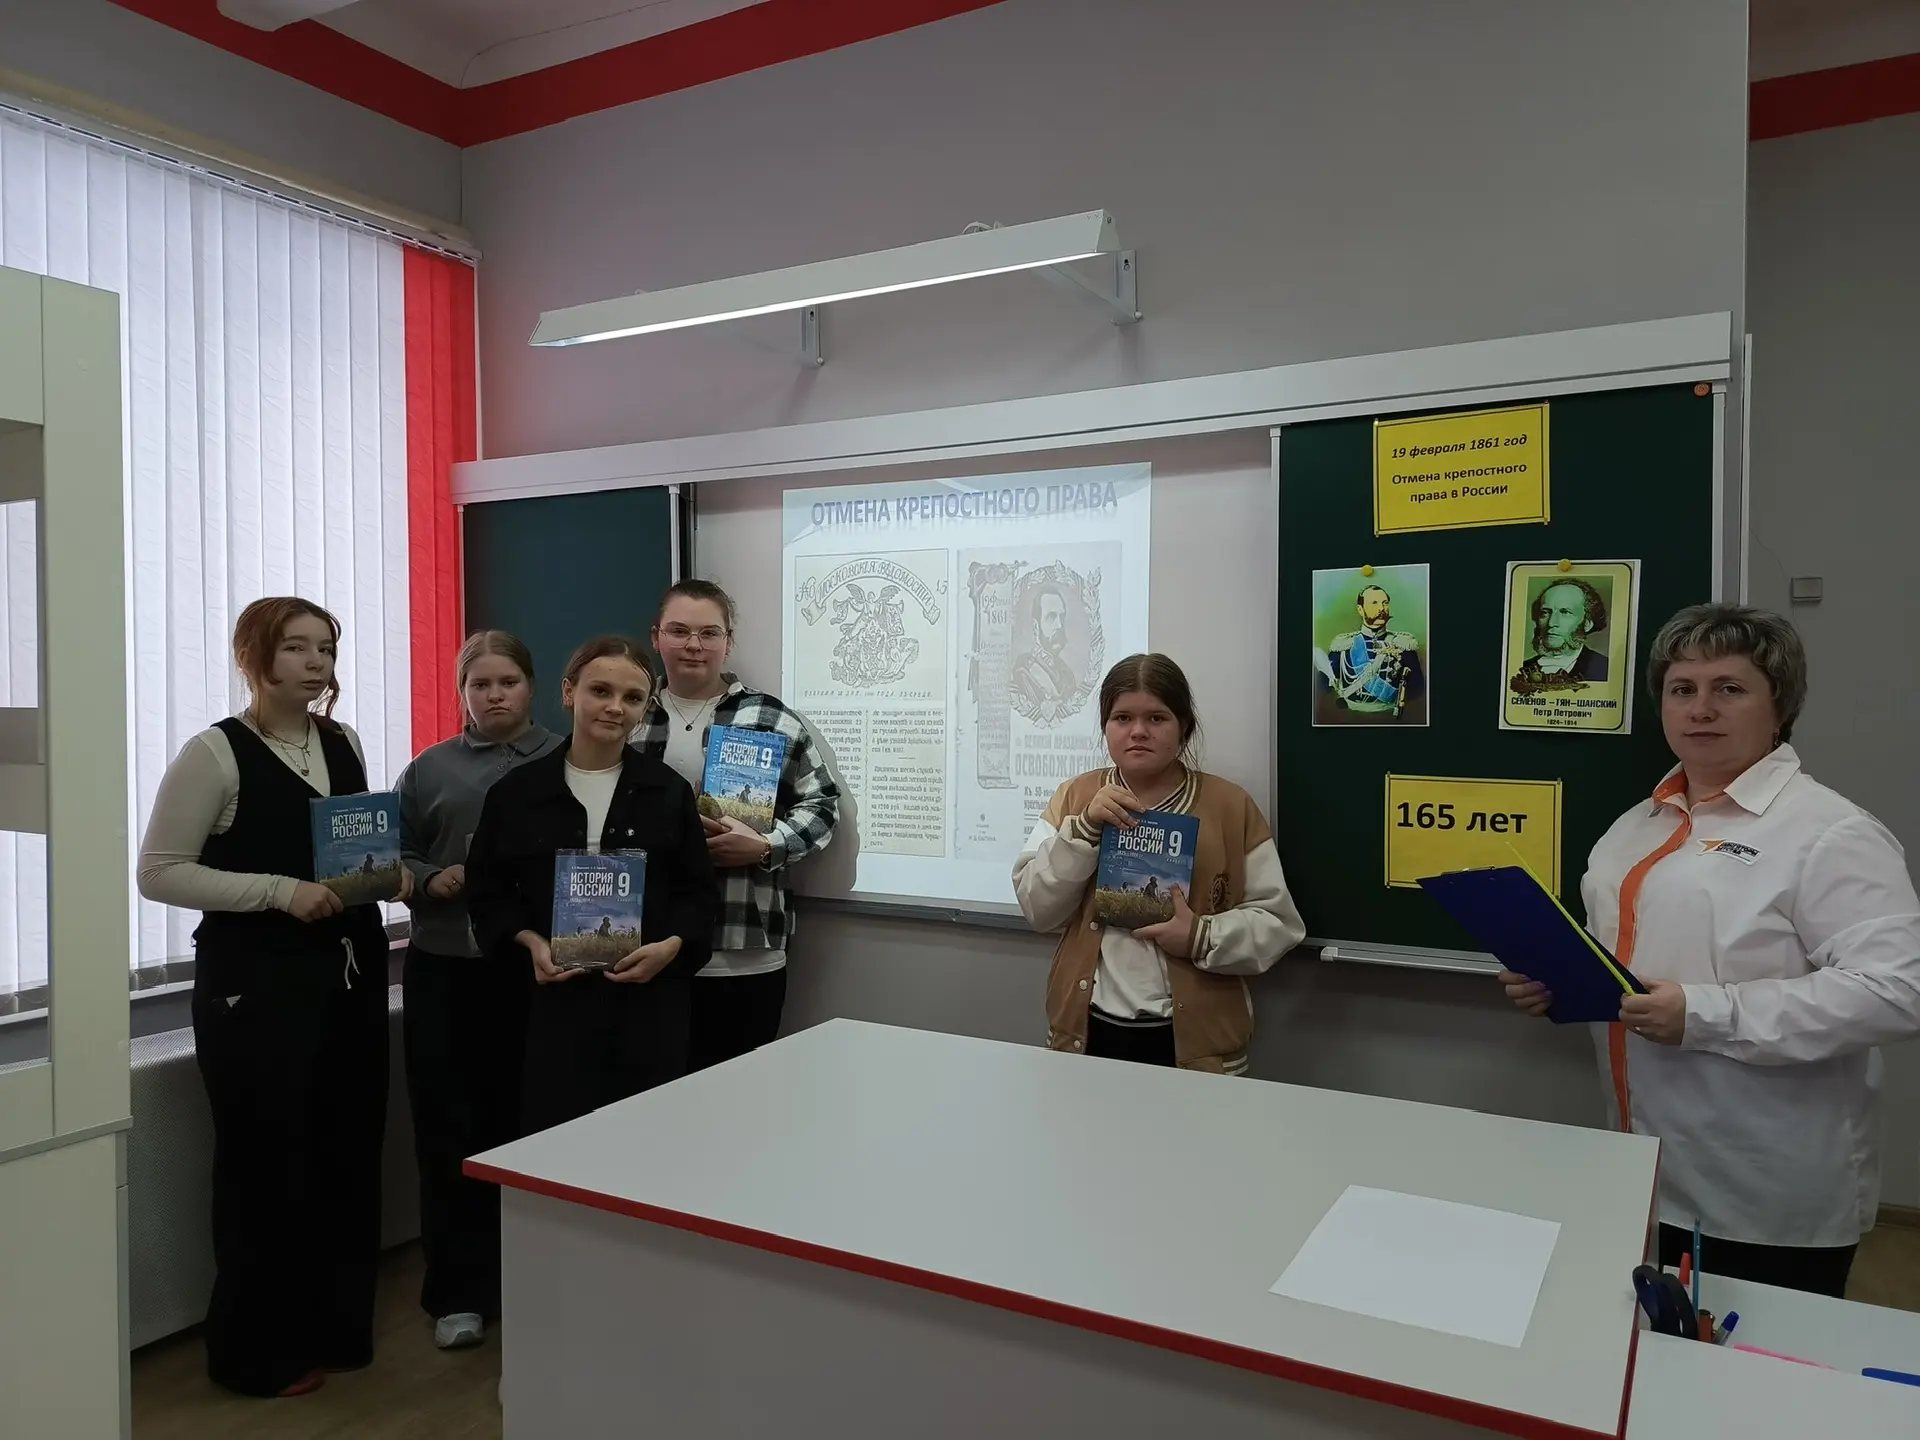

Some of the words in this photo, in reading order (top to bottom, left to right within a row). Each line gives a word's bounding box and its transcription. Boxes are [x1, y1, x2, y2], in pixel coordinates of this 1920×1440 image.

[1391, 447, 1406, 458] 19
[1409, 442, 1465, 458] февраля
[1469, 437, 1500, 450] 1861
[1504, 434, 1527, 447] год
[1392, 471, 1440, 485] Отмена
[1444, 464, 1527, 481] крепостного
[811, 498, 891, 526] ОТМЕНА
[896, 486, 1039, 521] КРЕПОСТНОГО
[1046, 481, 1118, 511] ПРАВА
[1410, 490, 1447, 504] права
[1451, 489, 1458, 498] в
[1462, 484, 1508, 497] России
[1533, 708, 1552, 717] Петр
[1554, 709, 1592, 718] Петрович
[721, 741, 759, 755] ИСТОРИЯ
[760, 747, 773, 769] 9
[719, 751, 757, 767] РОССИИ
[331, 811, 372, 827] ИСТОРИЯ
[376, 810, 388, 833] 9
[1397, 802, 1456, 830] 165
[1466, 811, 1527, 833] лет
[332, 822, 373, 839] РОССИИ
[1118, 835, 1163, 854] РОССИИ
[1168, 830, 1183, 857] 9
[570, 872, 613, 884] ИСТОРИЯ
[618, 872, 631, 897] 9
[569, 883, 613, 897] РОССИИ
